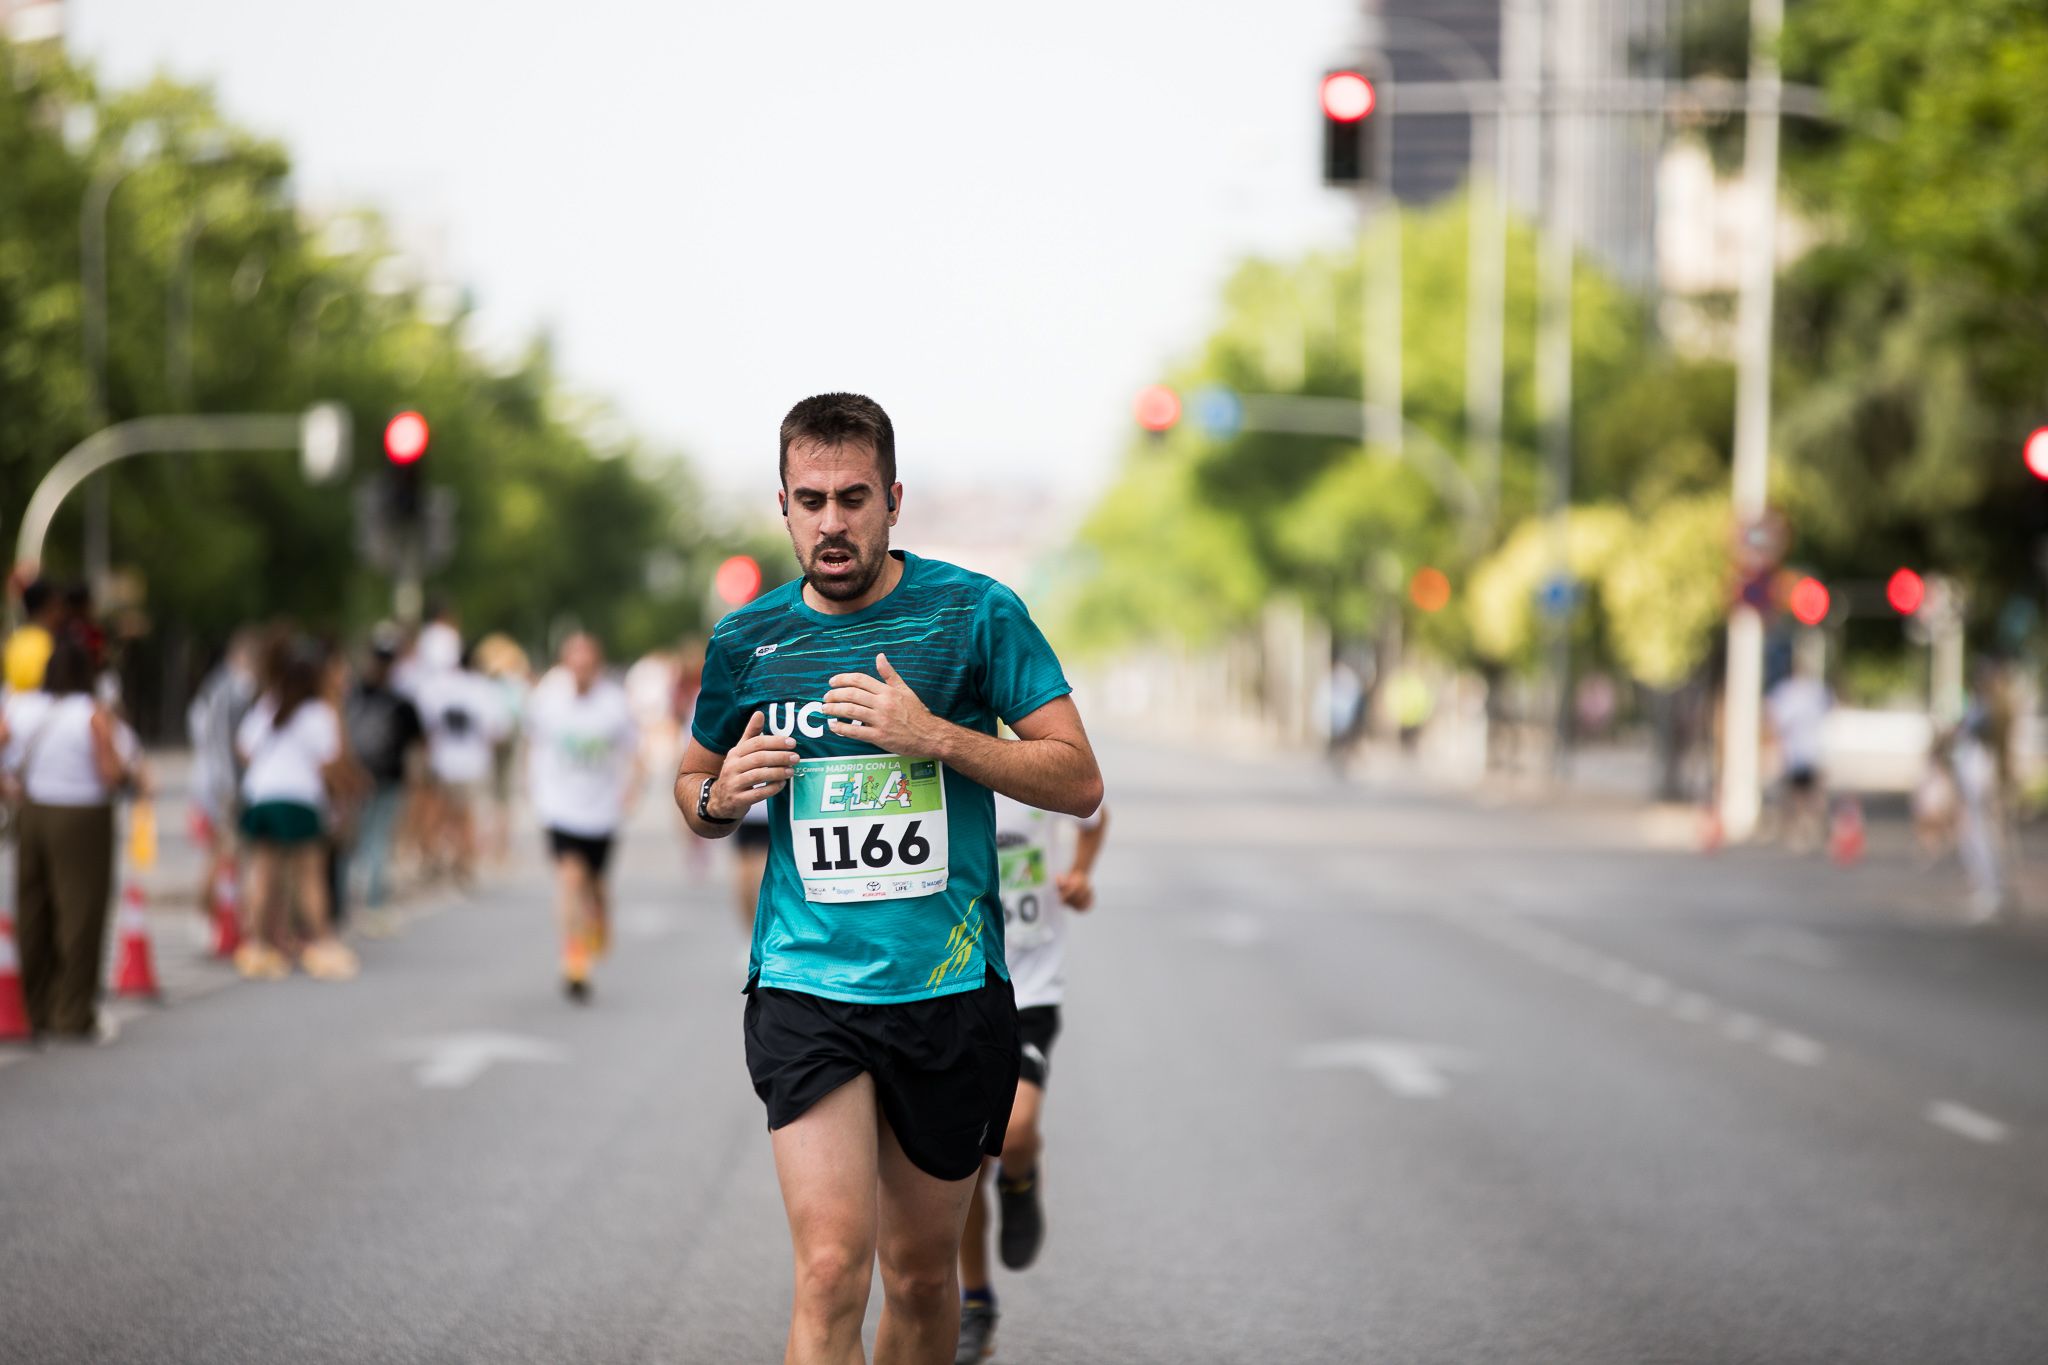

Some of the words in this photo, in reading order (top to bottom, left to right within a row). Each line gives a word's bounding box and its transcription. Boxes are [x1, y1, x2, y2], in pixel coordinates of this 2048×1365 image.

[826, 763, 864, 773] MADRID
[865, 762, 886, 771] CON
[888, 761, 901, 769] LA
[820, 770, 912, 812] ELA
[809, 820, 930, 871] 1166
